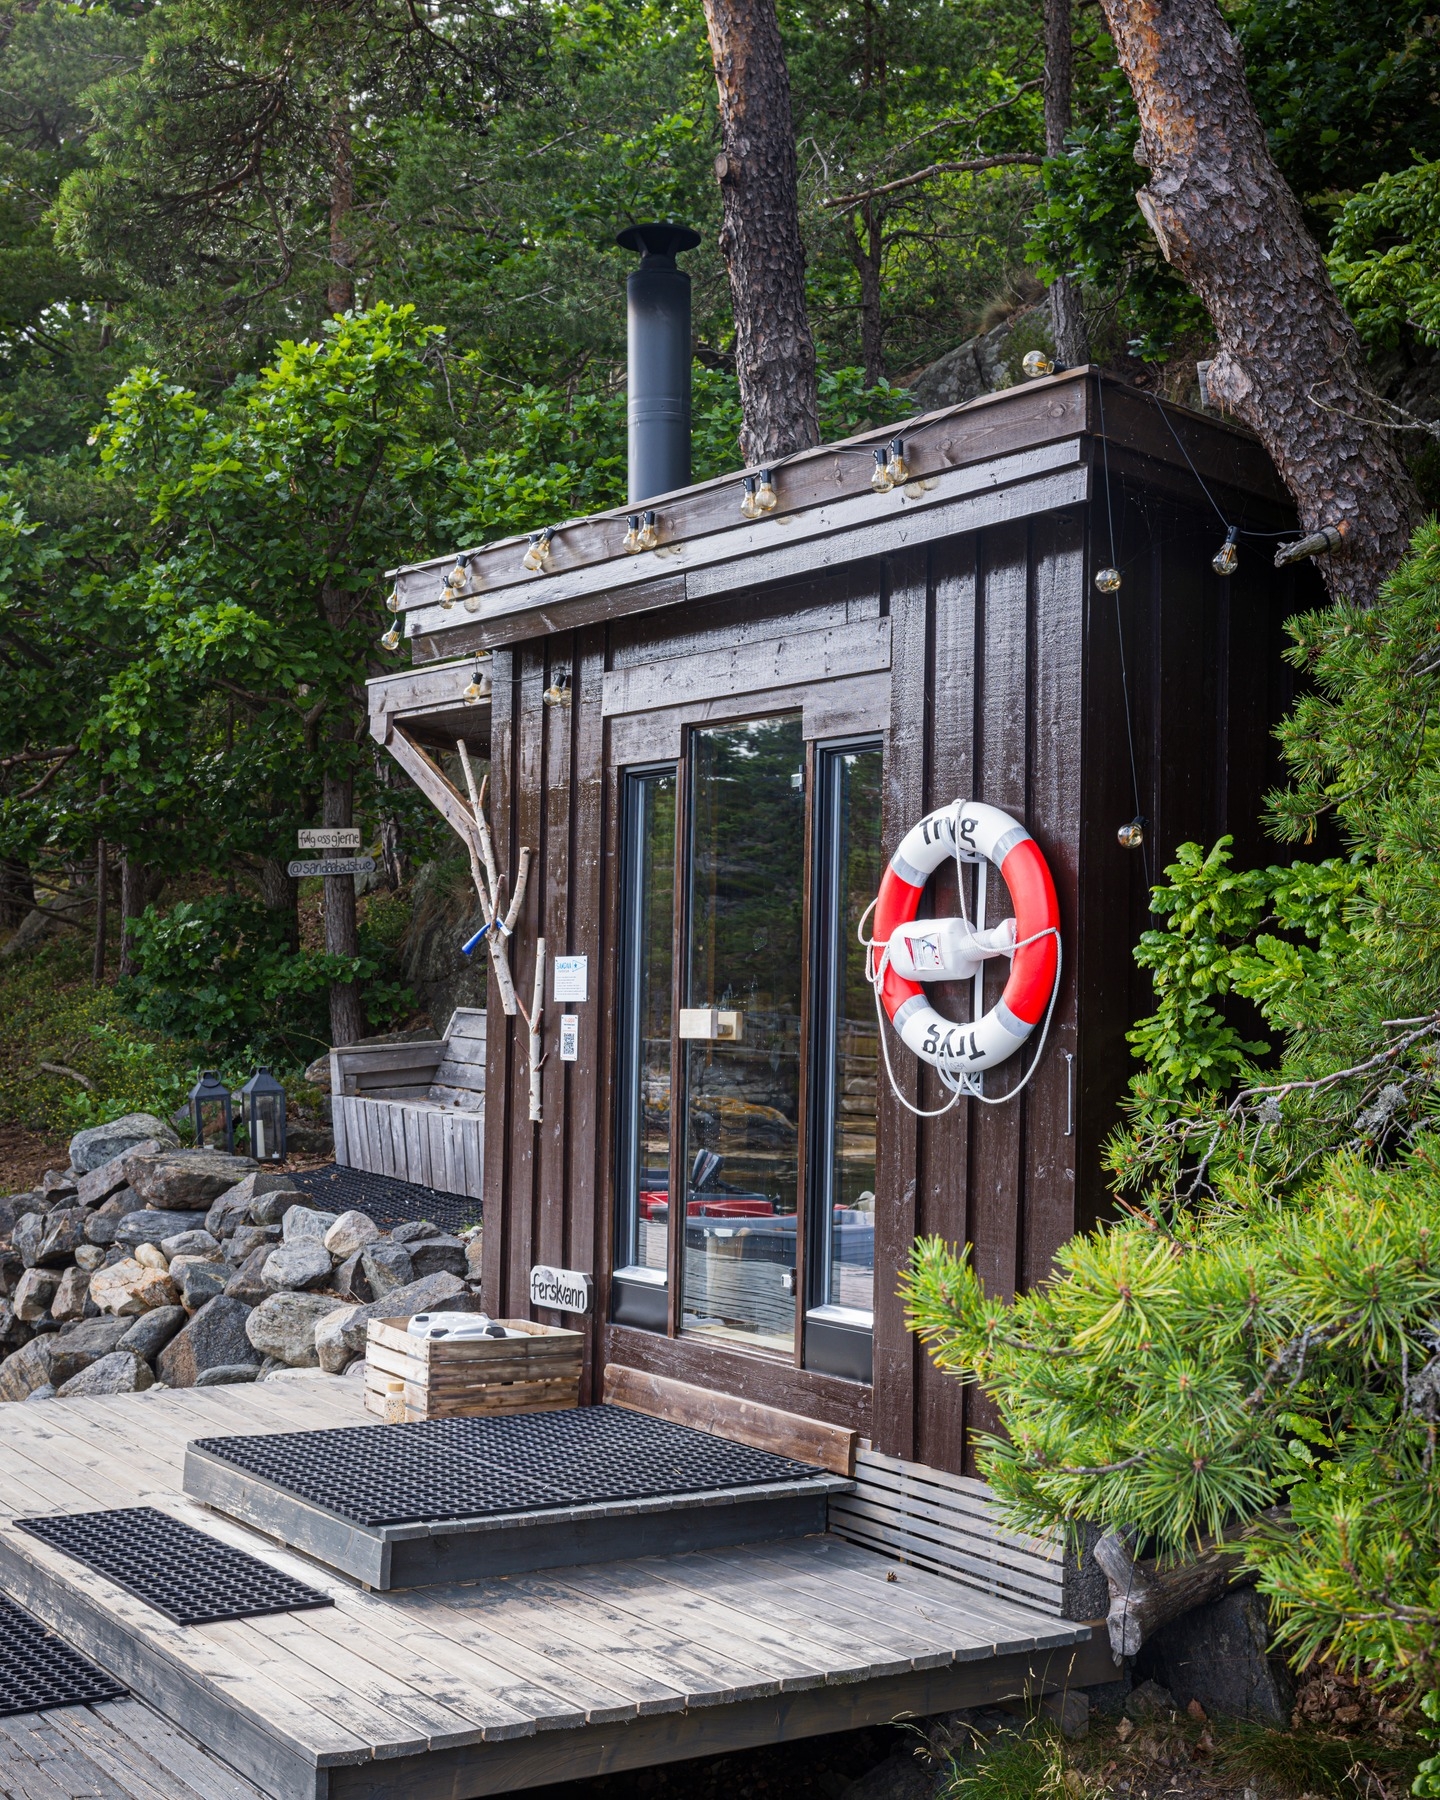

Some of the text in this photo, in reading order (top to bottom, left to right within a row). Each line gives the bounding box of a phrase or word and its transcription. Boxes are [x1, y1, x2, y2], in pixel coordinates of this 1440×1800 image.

[317, 834, 331, 845] oss
[331, 831, 360, 848] gjerne
[922, 1024, 986, 1061] Tryg
[531, 1272, 585, 1310] ferskvann
